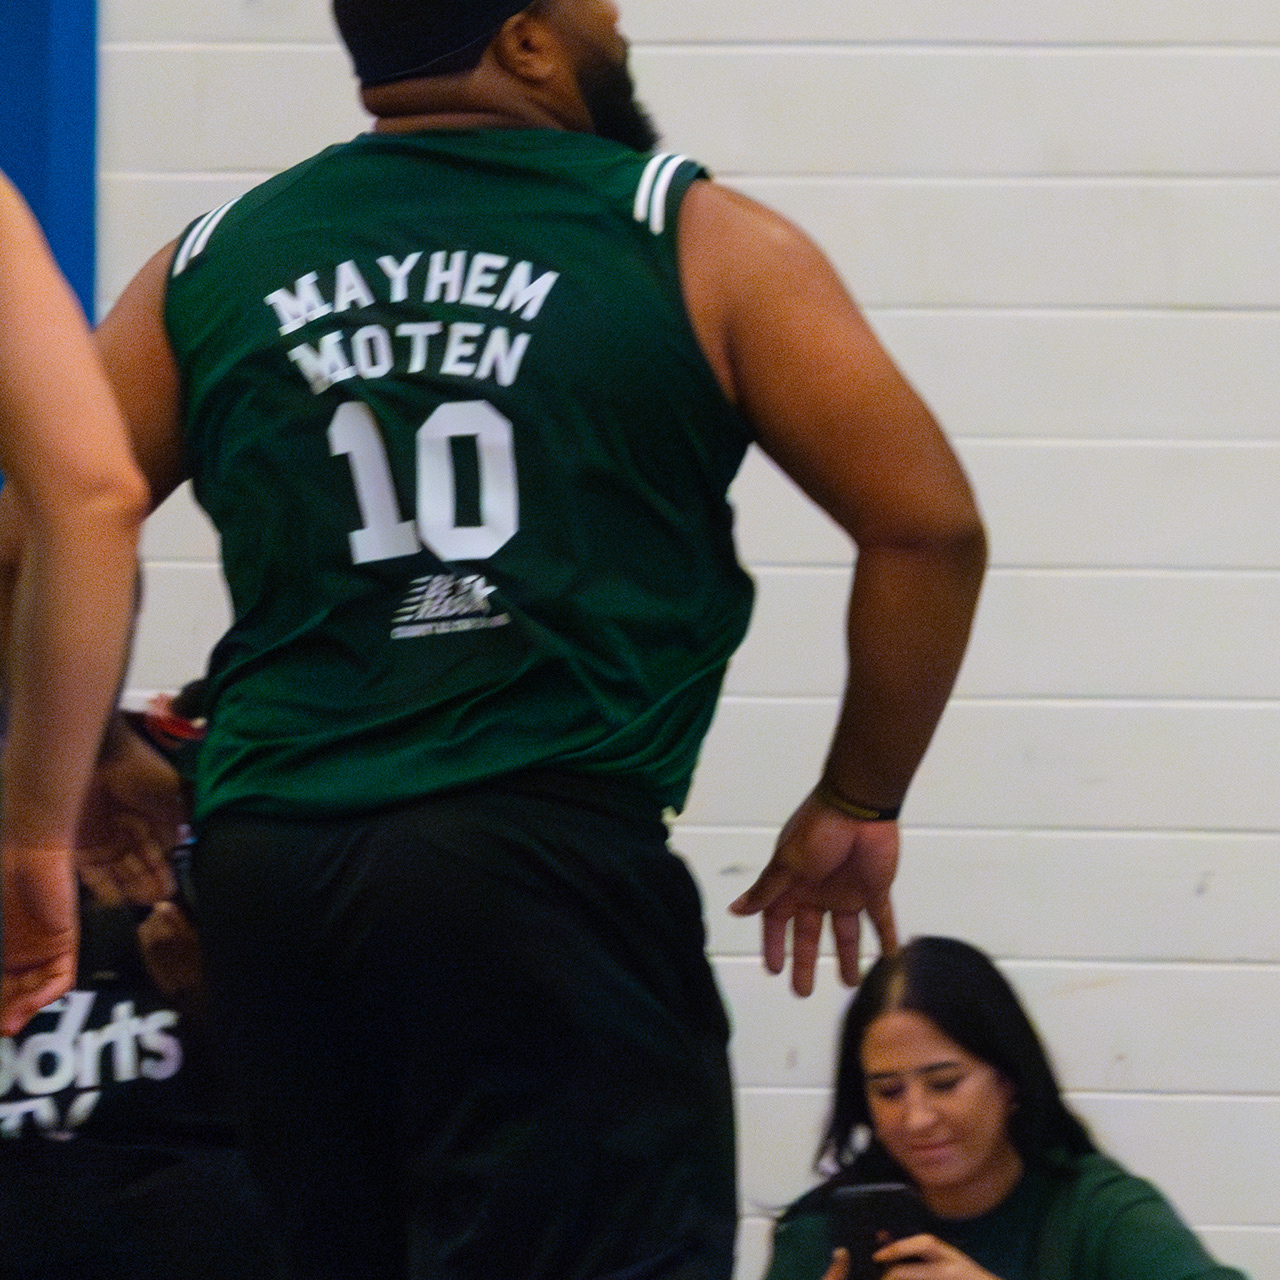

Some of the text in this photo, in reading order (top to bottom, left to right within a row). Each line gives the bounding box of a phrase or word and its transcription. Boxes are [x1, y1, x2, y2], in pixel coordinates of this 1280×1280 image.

[263, 250, 561, 337] MAYHEM
[287, 321, 532, 396] MOTEN
[327, 399, 520, 565] 10
